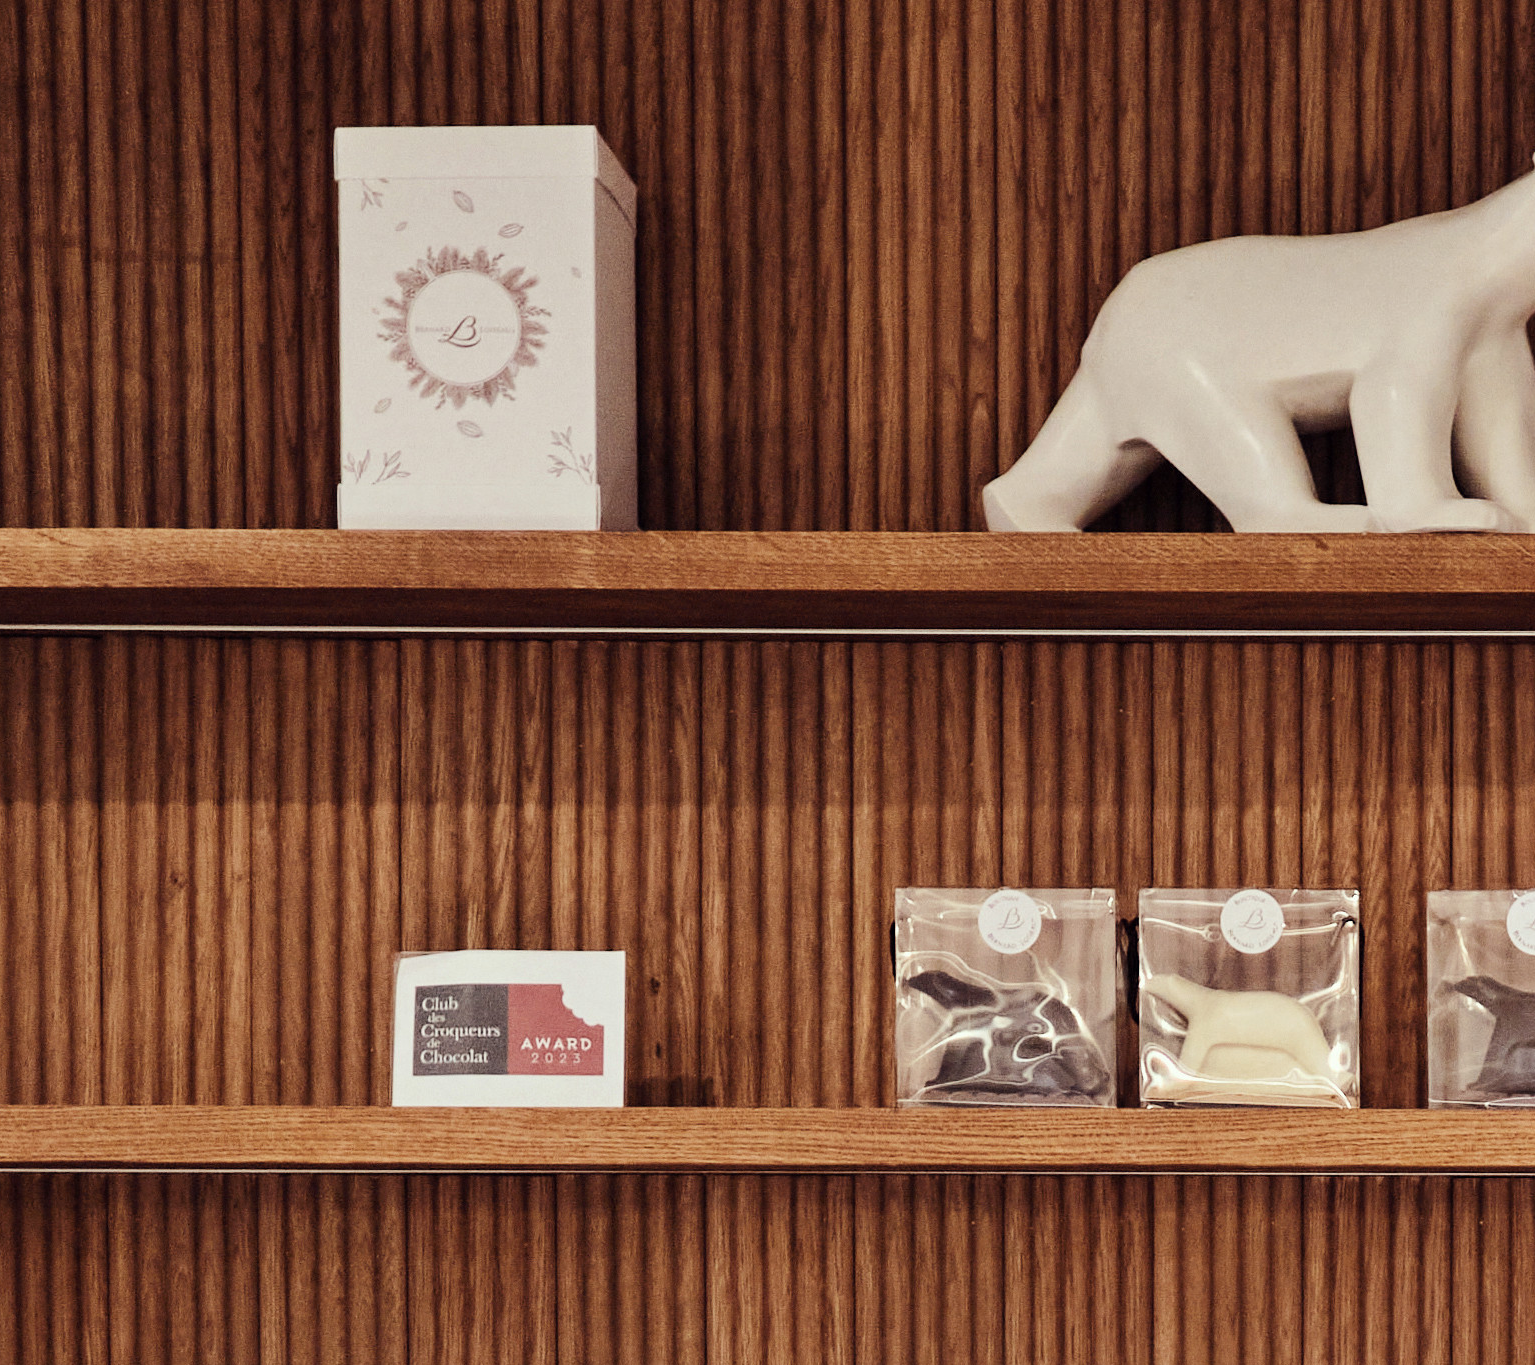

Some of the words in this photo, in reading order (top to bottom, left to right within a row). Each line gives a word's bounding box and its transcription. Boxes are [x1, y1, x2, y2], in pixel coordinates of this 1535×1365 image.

[421, 997, 458, 1012] Club
[427, 1012, 445, 1023] des
[420, 1024, 501, 1041] Croqueurs
[426, 1038, 441, 1048] de
[521, 1037, 592, 1051] AWARD
[420, 1049, 489, 1064] Chocolat
[531, 1053, 581, 1064] 2023
